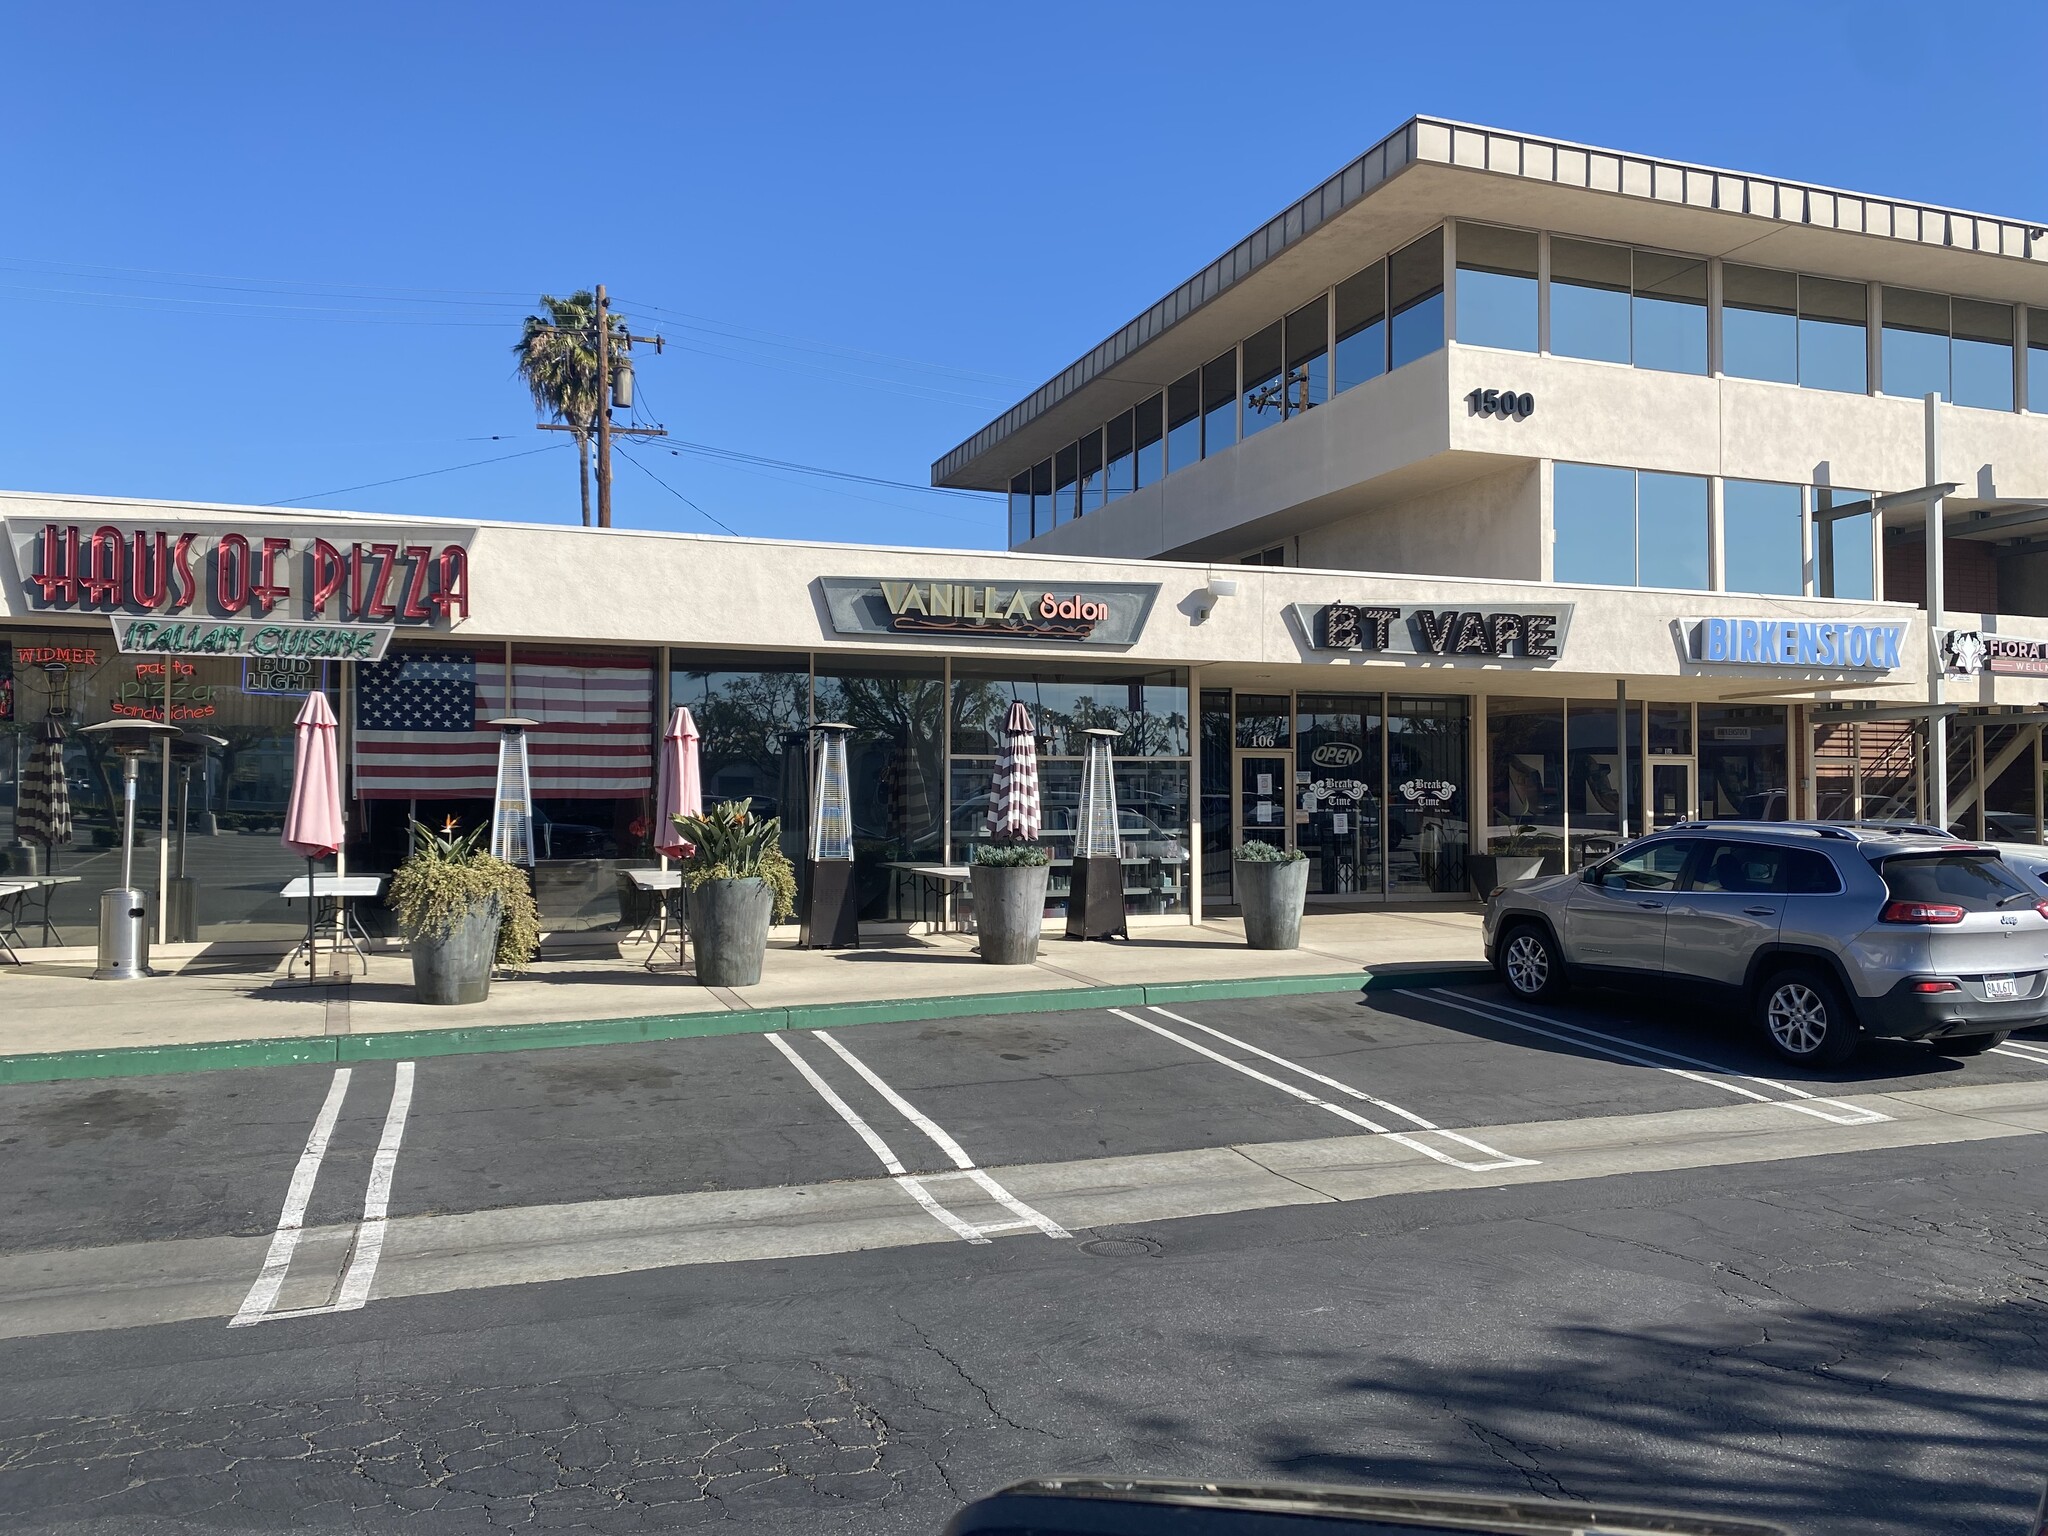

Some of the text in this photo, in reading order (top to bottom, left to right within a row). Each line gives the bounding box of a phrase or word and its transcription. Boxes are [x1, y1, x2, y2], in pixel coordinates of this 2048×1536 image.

[1468, 387, 1534, 418] 1500
[31, 523, 469, 618] HAUS OF PIZZA
[879, 581, 1109, 621] VANILLA Salon
[123, 620, 378, 658] ITALIAN CUISINE
[1325, 604, 1558, 657] BT VAPE
[1708, 618, 1901, 669] BIRKENSTOCK
[1989, 640, 2040, 659] FLORA
[17, 647, 98, 666] WIDMER
[258, 657, 312, 675] BUD
[121, 681, 212, 704] pizza
[1251, 735, 1275, 748] 106
[1315, 745, 1357, 765] OPEN
[1325, 778, 1353, 790] Break
[1414, 778, 1442, 790] Break
[1328, 796, 1351, 806] Time
[1417, 796, 1440, 806] Time
